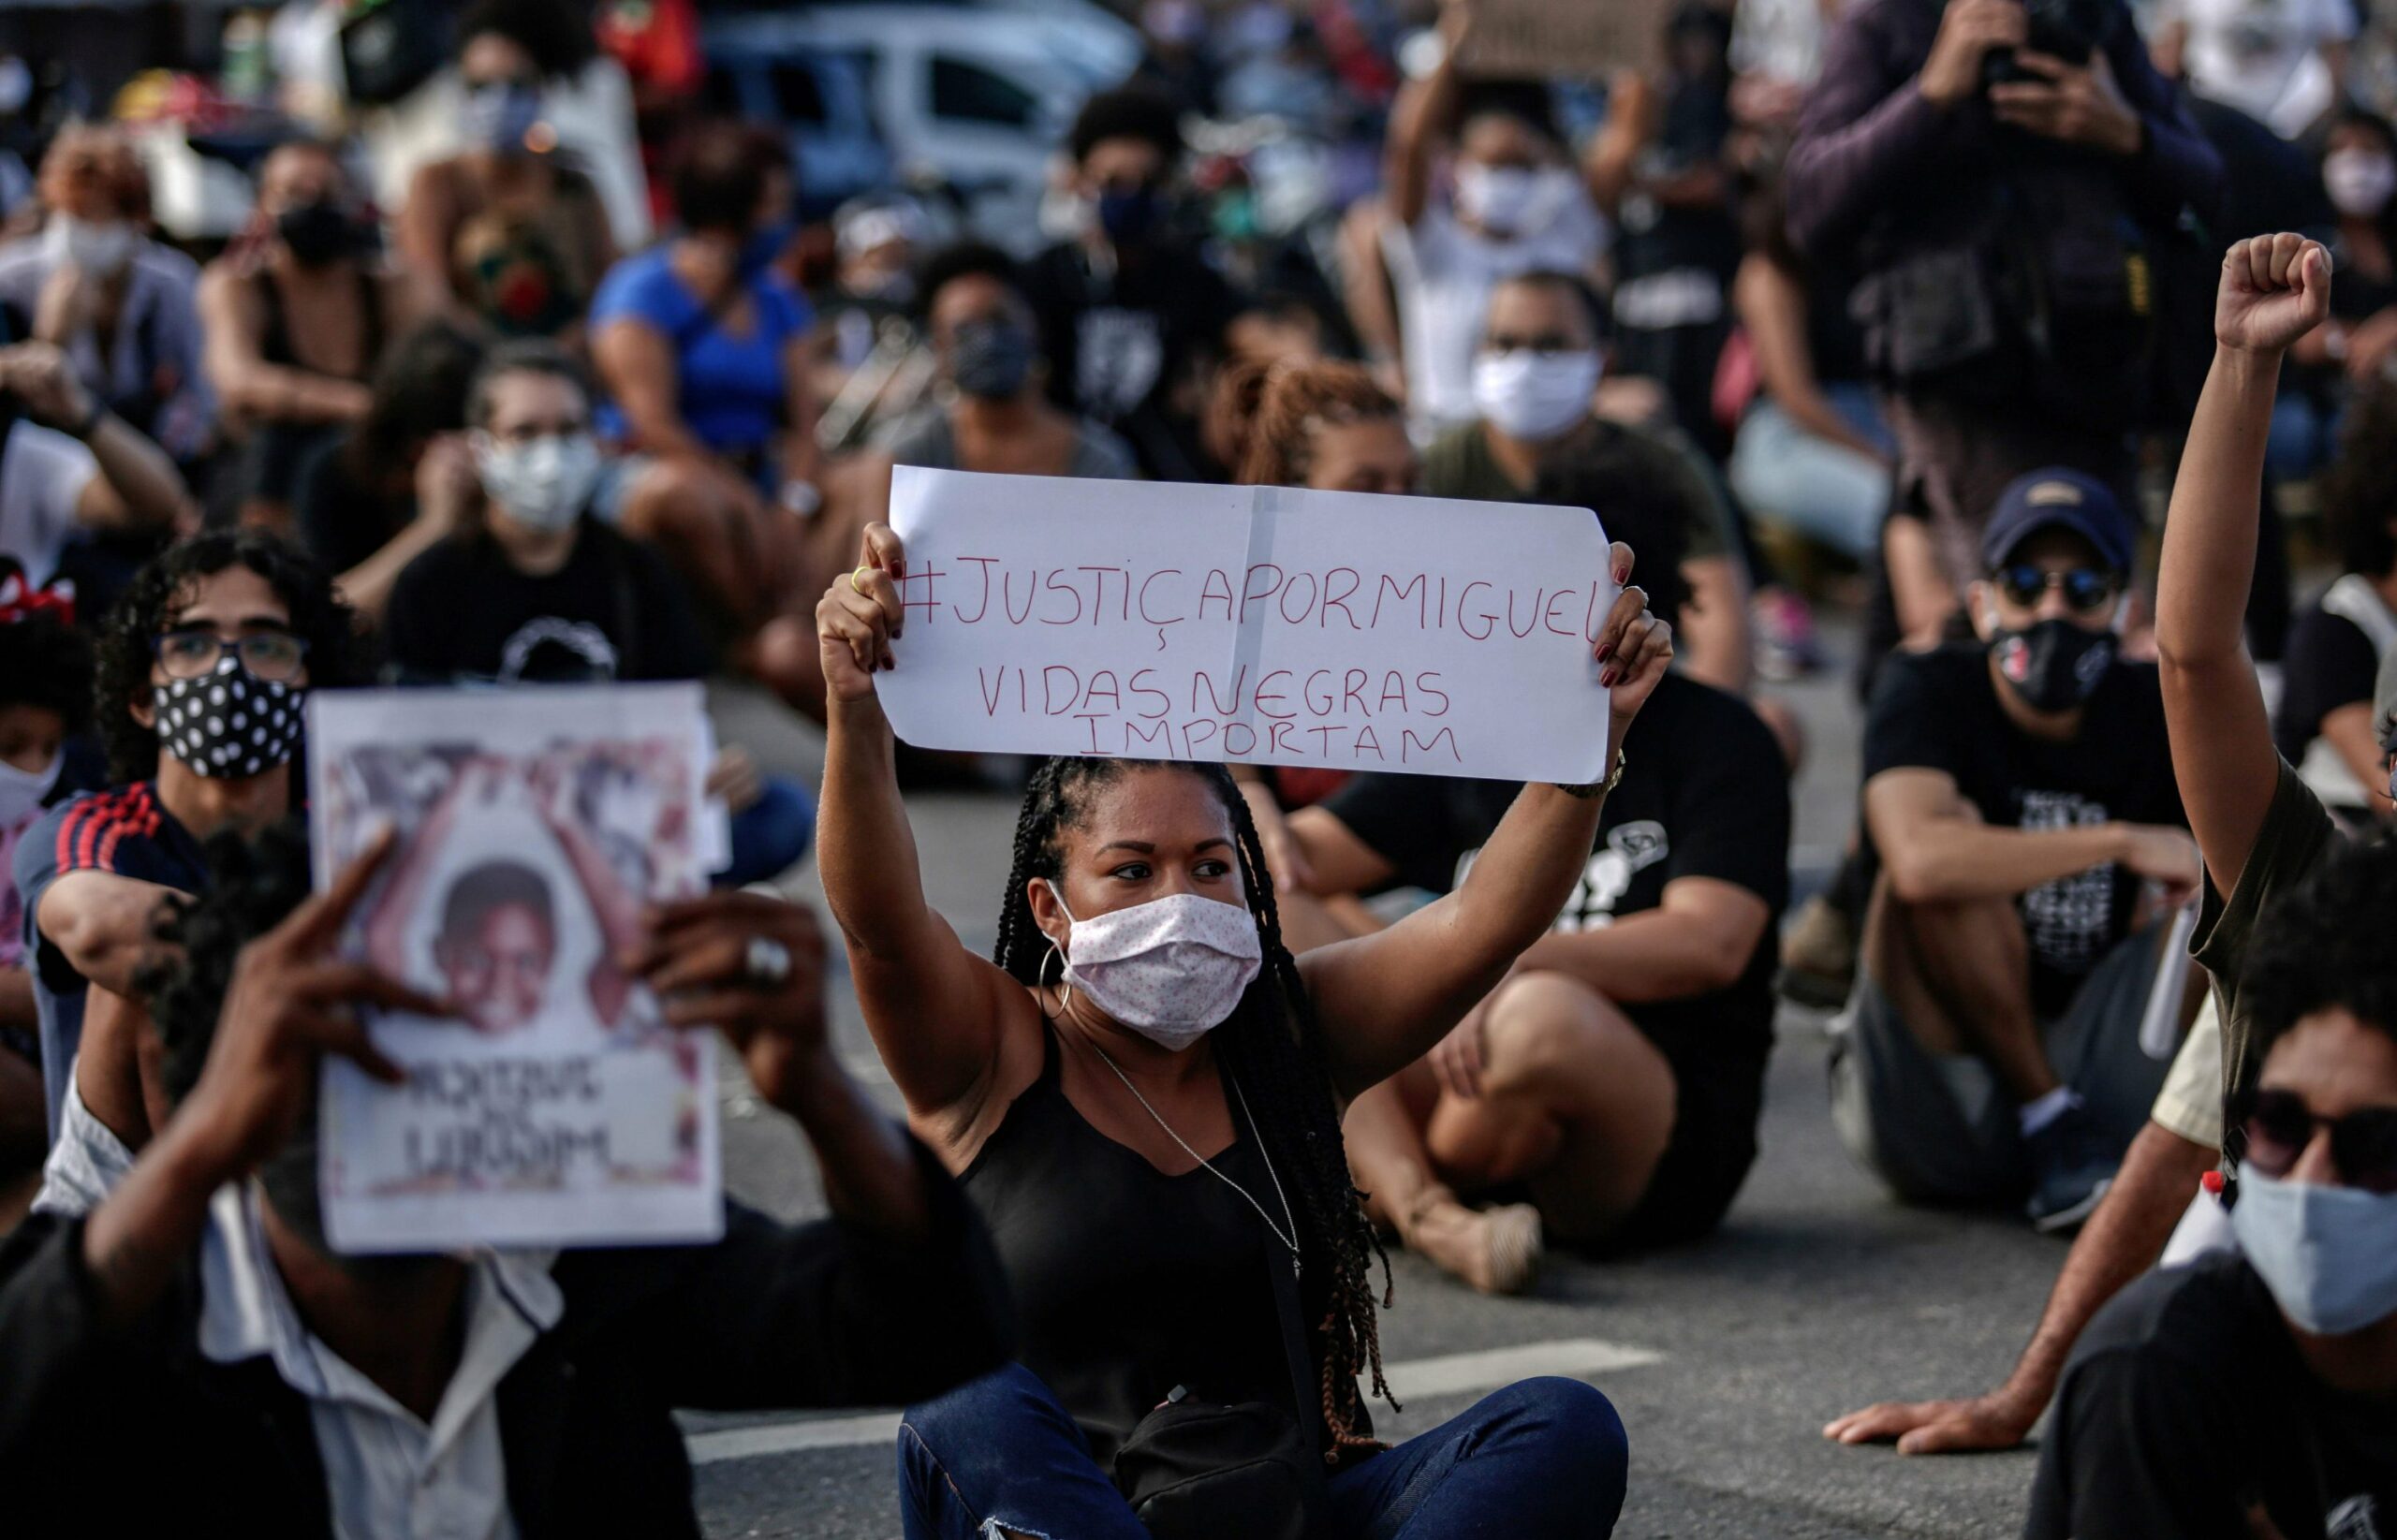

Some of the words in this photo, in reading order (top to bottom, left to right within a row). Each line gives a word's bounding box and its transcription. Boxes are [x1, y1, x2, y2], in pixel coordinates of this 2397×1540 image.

[979, 666, 1170, 718] VIDAS
[1193, 665, 1448, 718] NEGRAS
[1073, 714, 1462, 763] IMPORTAM
